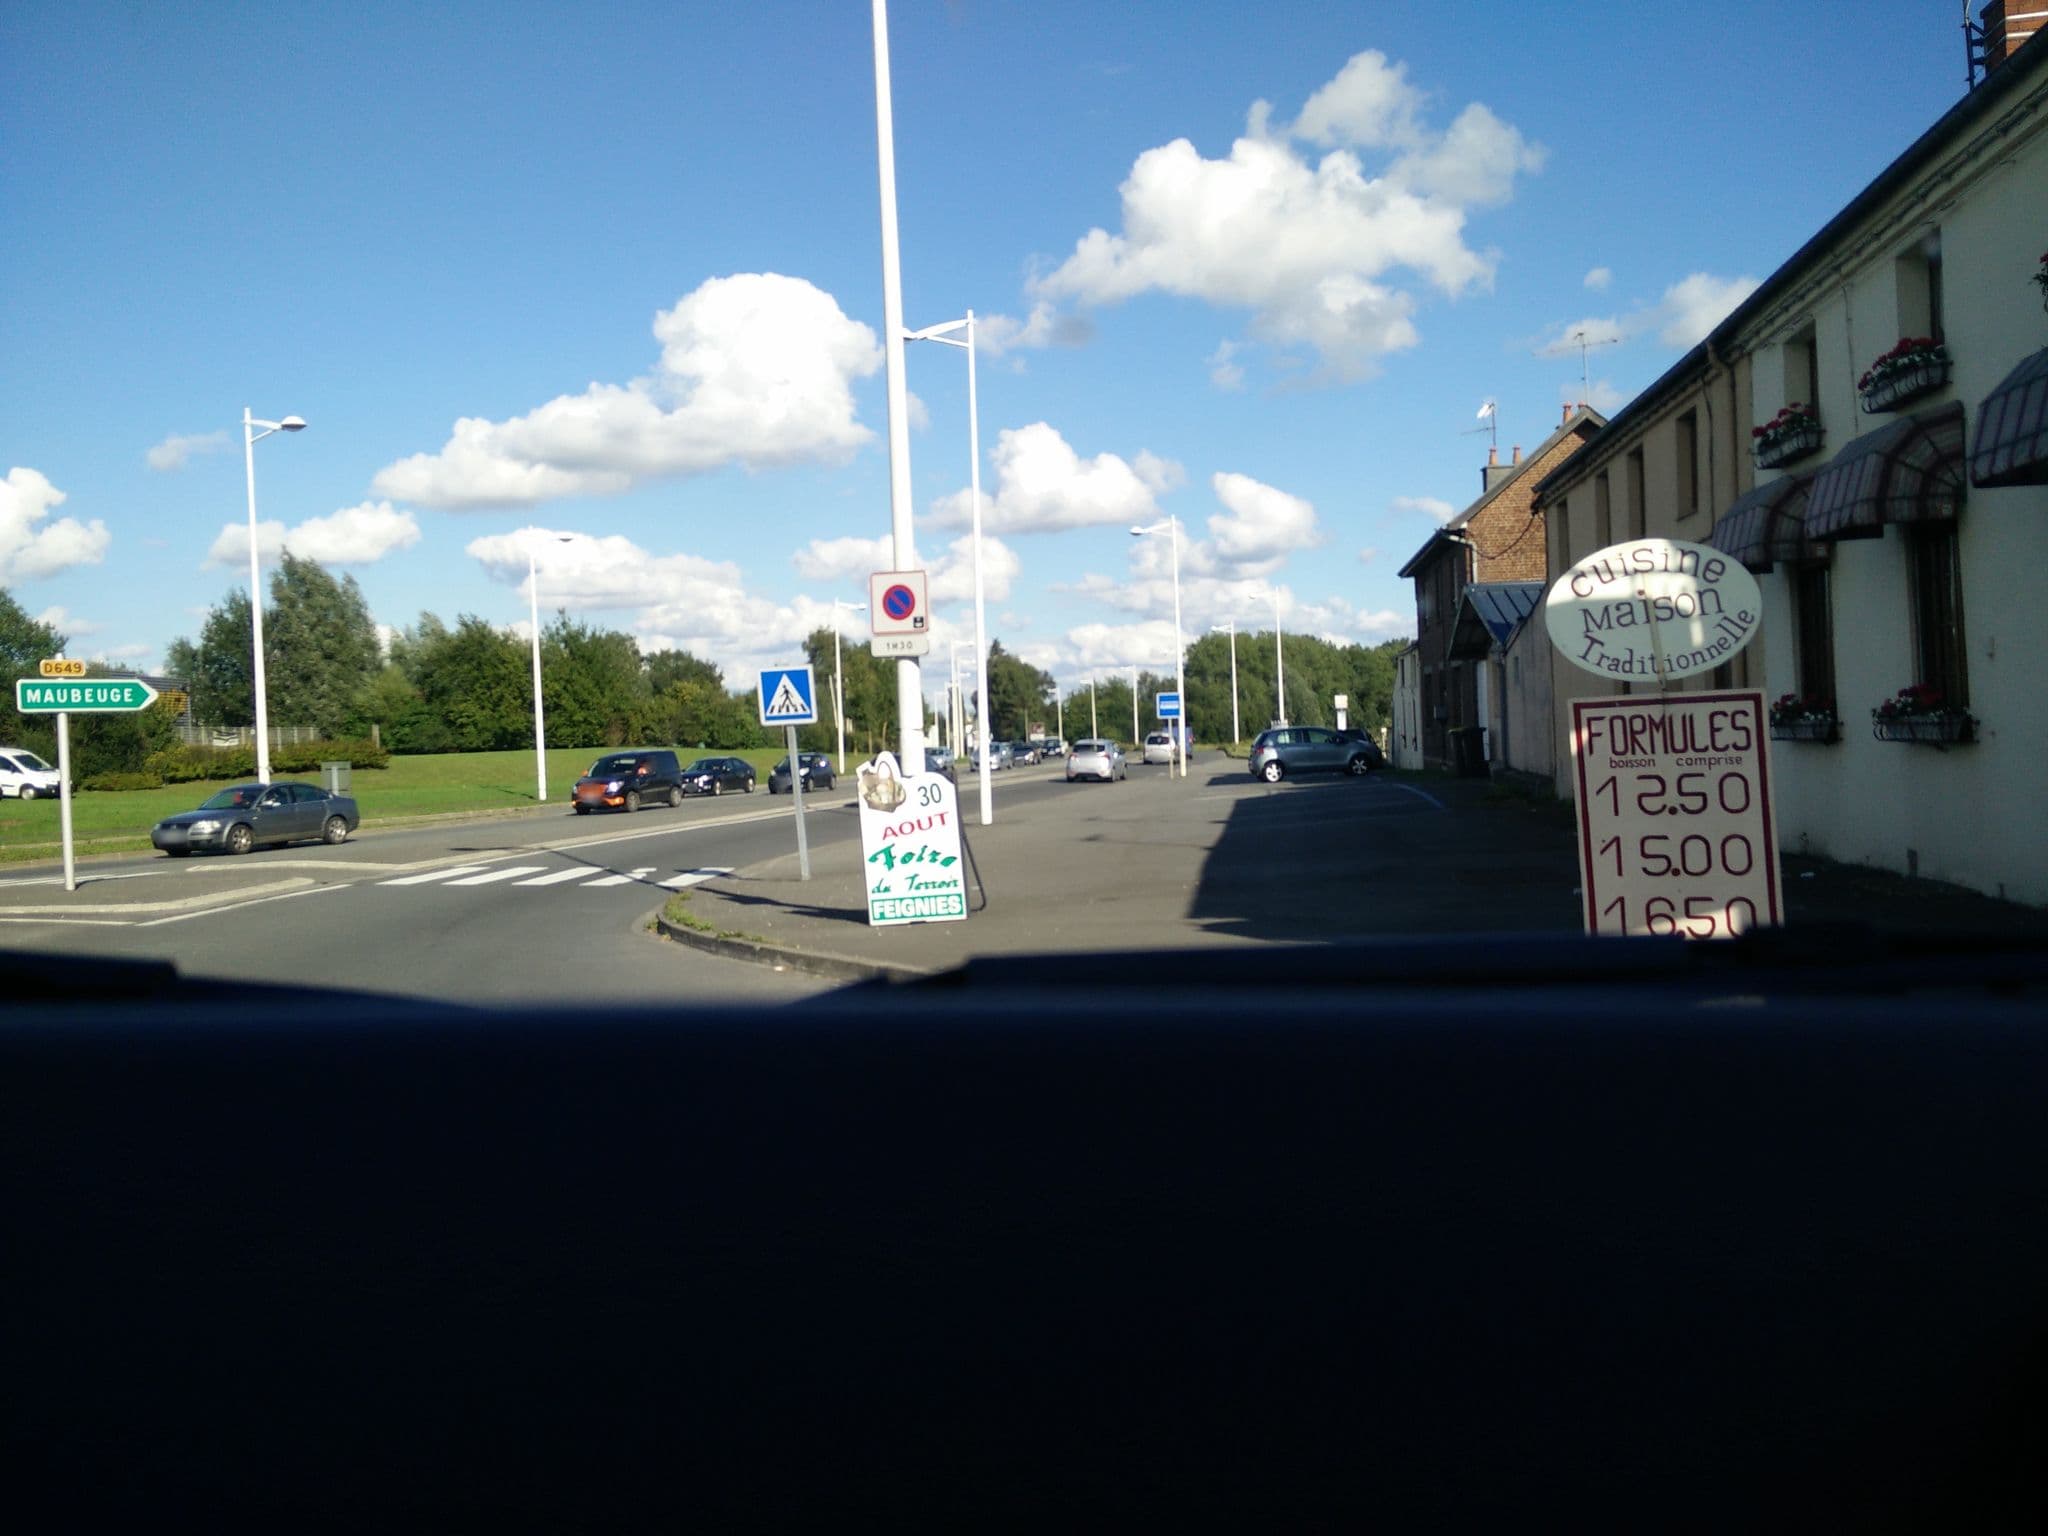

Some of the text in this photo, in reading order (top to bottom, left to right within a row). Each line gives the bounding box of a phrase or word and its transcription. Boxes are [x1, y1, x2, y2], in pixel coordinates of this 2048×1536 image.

[1578, 587, 1725, 634] Maison
[1578, 608, 1755, 675] Traditionnelle
[44, 662, 82, 674] D649
[26, 687, 134, 704] MAUBEUGE
[1586, 710, 1752, 757] FORMULES
[1609, 754, 1743, 770] boisson comprise
[917, 783, 942, 807] 30
[1595, 771, 1751, 816] 12.50
[882, 811, 950, 841] AOUT
[868, 843, 958, 872] Foire
[1600, 833, 1753, 877] 15.00
[871, 873, 959, 894] du Terroir
[872, 895, 963, 920] FEIGNIES
